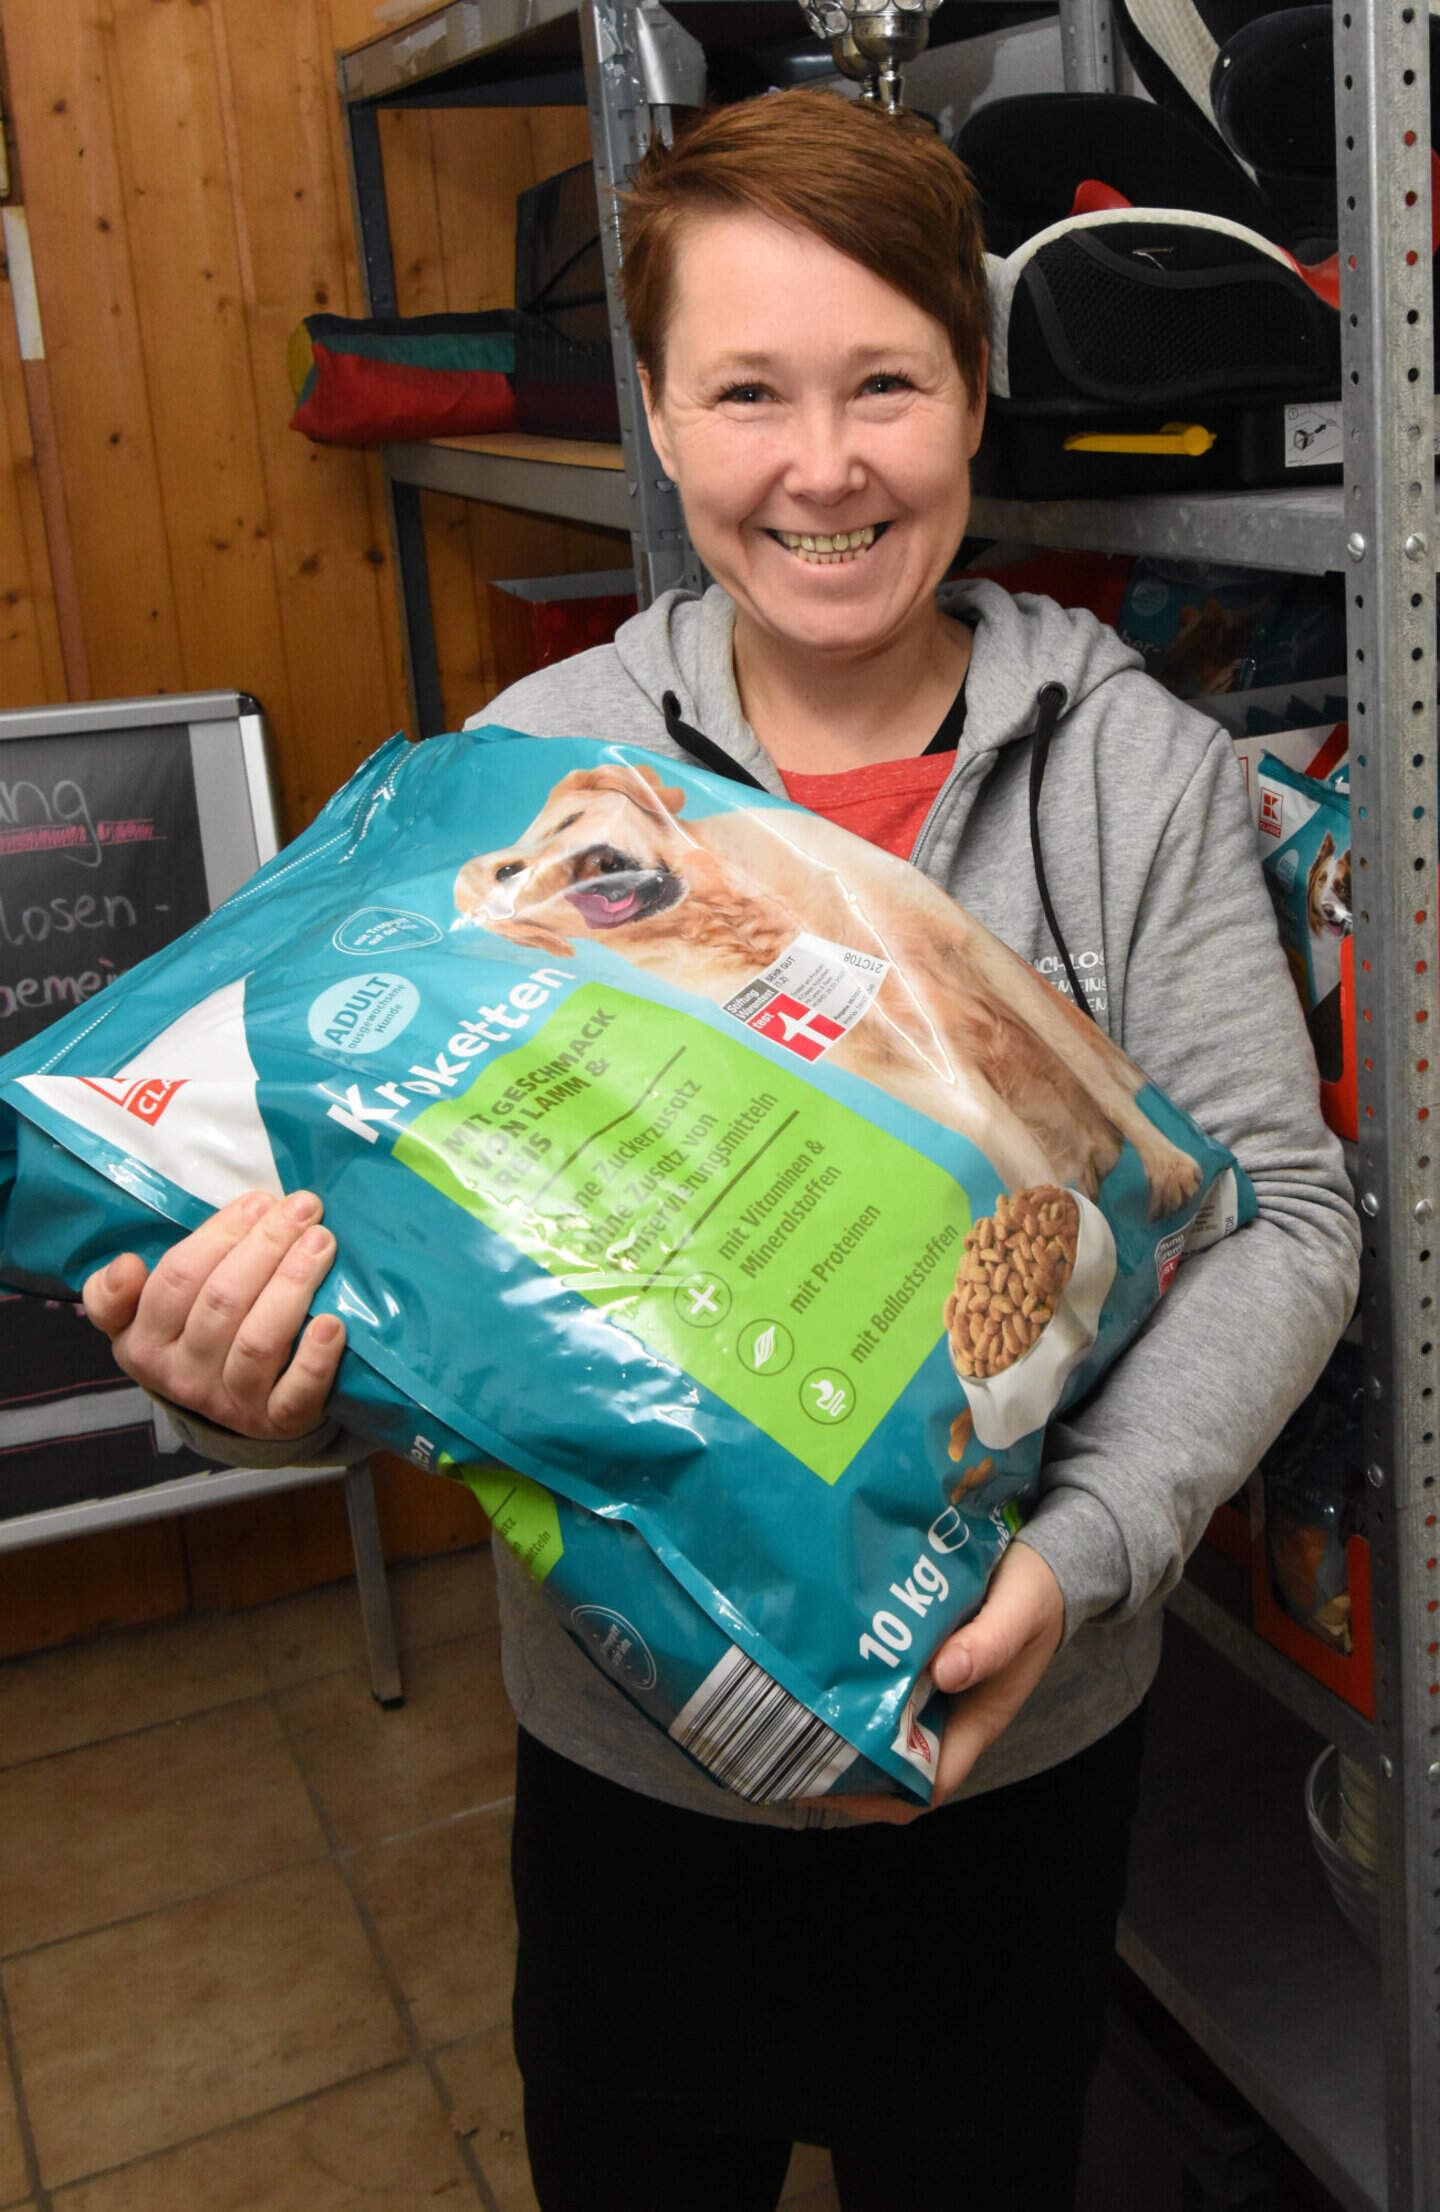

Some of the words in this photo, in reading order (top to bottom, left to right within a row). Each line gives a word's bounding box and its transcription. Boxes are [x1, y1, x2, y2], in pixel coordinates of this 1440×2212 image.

[324, 976, 391, 1046] ADULT
[375, 1004, 405, 1034] Hunde
[780, 956, 796, 971] GUT
[326, 967, 576, 1144] Kroketten
[752, 1012, 775, 1030] test
[442, 1112, 494, 1155] MIT
[490, 1007, 617, 1116] GESCHMACK
[468, 1119, 529, 1171] VON
[520, 1076, 592, 1120] LAMM
[584, 1057, 611, 1078] &
[592, 1079, 702, 1181] Zuckerzusatz
[493, 1131, 553, 1187] REIS
[584, 1203, 635, 1257] ohne
[623, 1149, 690, 1204] Zusatz
[681, 1112, 719, 1148] von
[718, 1225, 751, 1261] mit
[739, 1152, 814, 1228] Vitaminen
[804, 1139, 826, 1157] &
[738, 1164, 843, 1279] Mineralstoffen
[789, 1278, 822, 1315] mit
[811, 1203, 882, 1284] Proteinen
[850, 1328, 881, 1364] mit
[869, 1223, 960, 1334] Ballaststoffen
[859, 1609, 913, 1669] 10
[889, 1554, 950, 1618] kg
